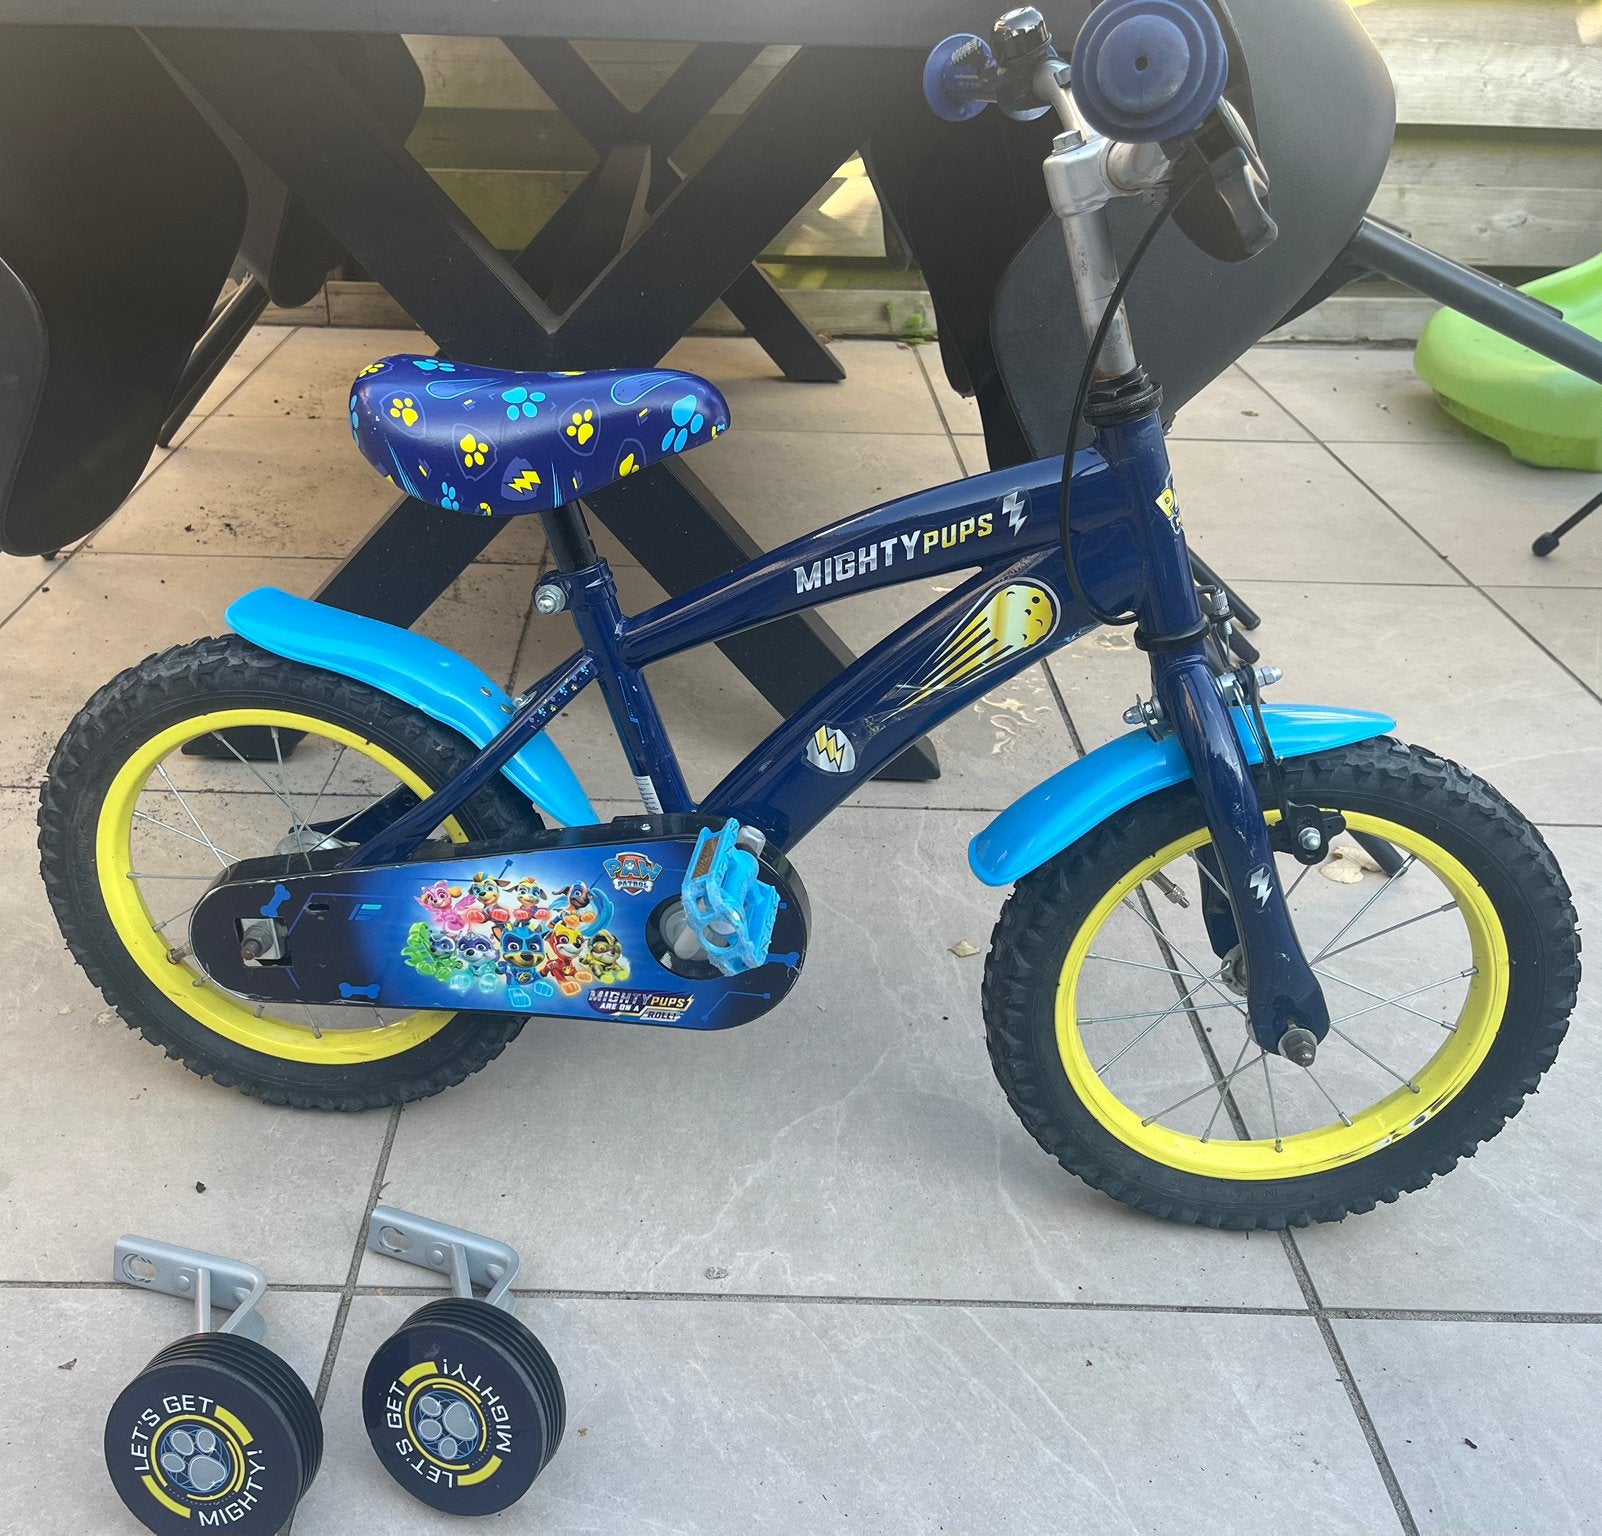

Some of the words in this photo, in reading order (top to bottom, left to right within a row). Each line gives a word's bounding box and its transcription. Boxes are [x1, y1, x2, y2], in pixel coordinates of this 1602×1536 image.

[603, 858, 663, 882] PAW
[617, 881, 649, 889] PATROL
[619, 1003, 631, 1011] ON
[646, 1011, 676, 1020] ROLL!
[386, 1381, 406, 1429] GET
[443, 1358, 513, 1453] MIGHTY!
[131, 1408, 161, 1471] LET'S
[162, 1394, 214, 1414] GET
[198, 1449, 266, 1527] MIGHTY!
[395, 1439, 453, 1488] LET'S
